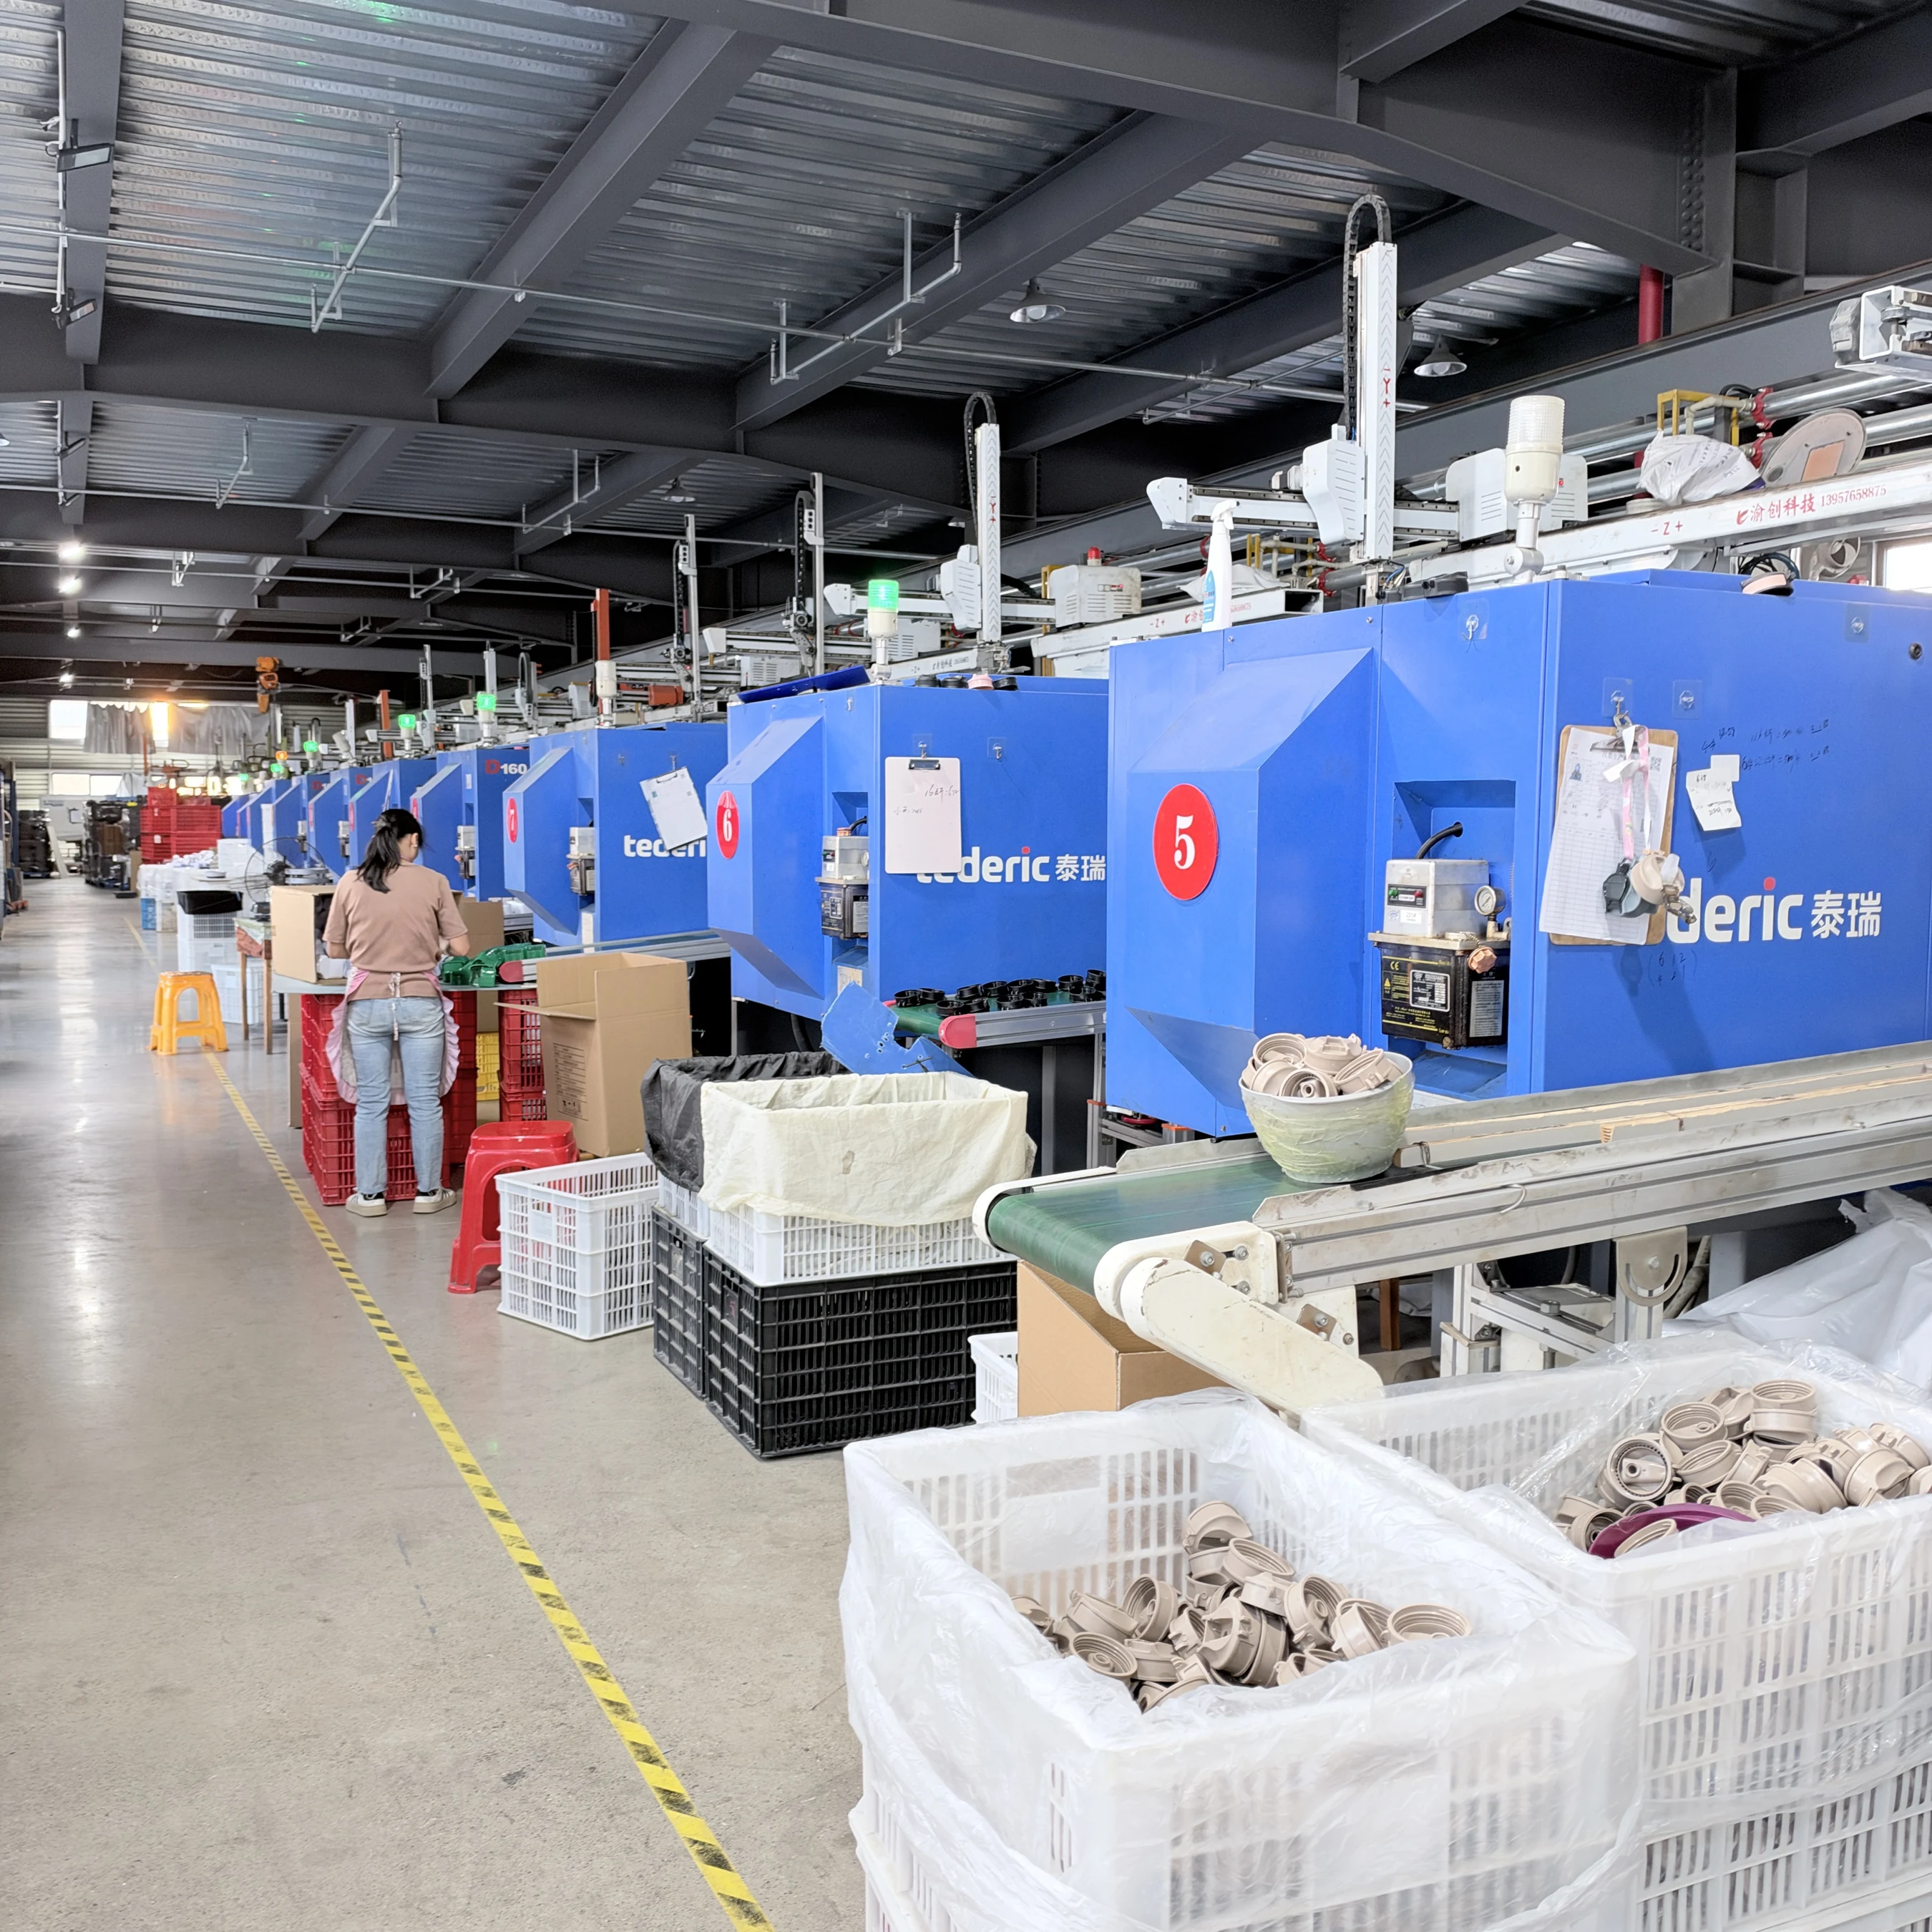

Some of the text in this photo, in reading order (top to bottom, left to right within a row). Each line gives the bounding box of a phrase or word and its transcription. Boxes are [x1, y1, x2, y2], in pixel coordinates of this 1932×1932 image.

[1821, 484, 1887, 507] 13957658875
[485, 759, 527, 775] D160
[509, 809, 515, 831] 7
[723, 809, 733, 842] 6
[1174, 814, 1196, 870] 5
[917, 846, 1106, 884] deric 泰瑞
[1810, 889, 1883, 940] 泰瑞
